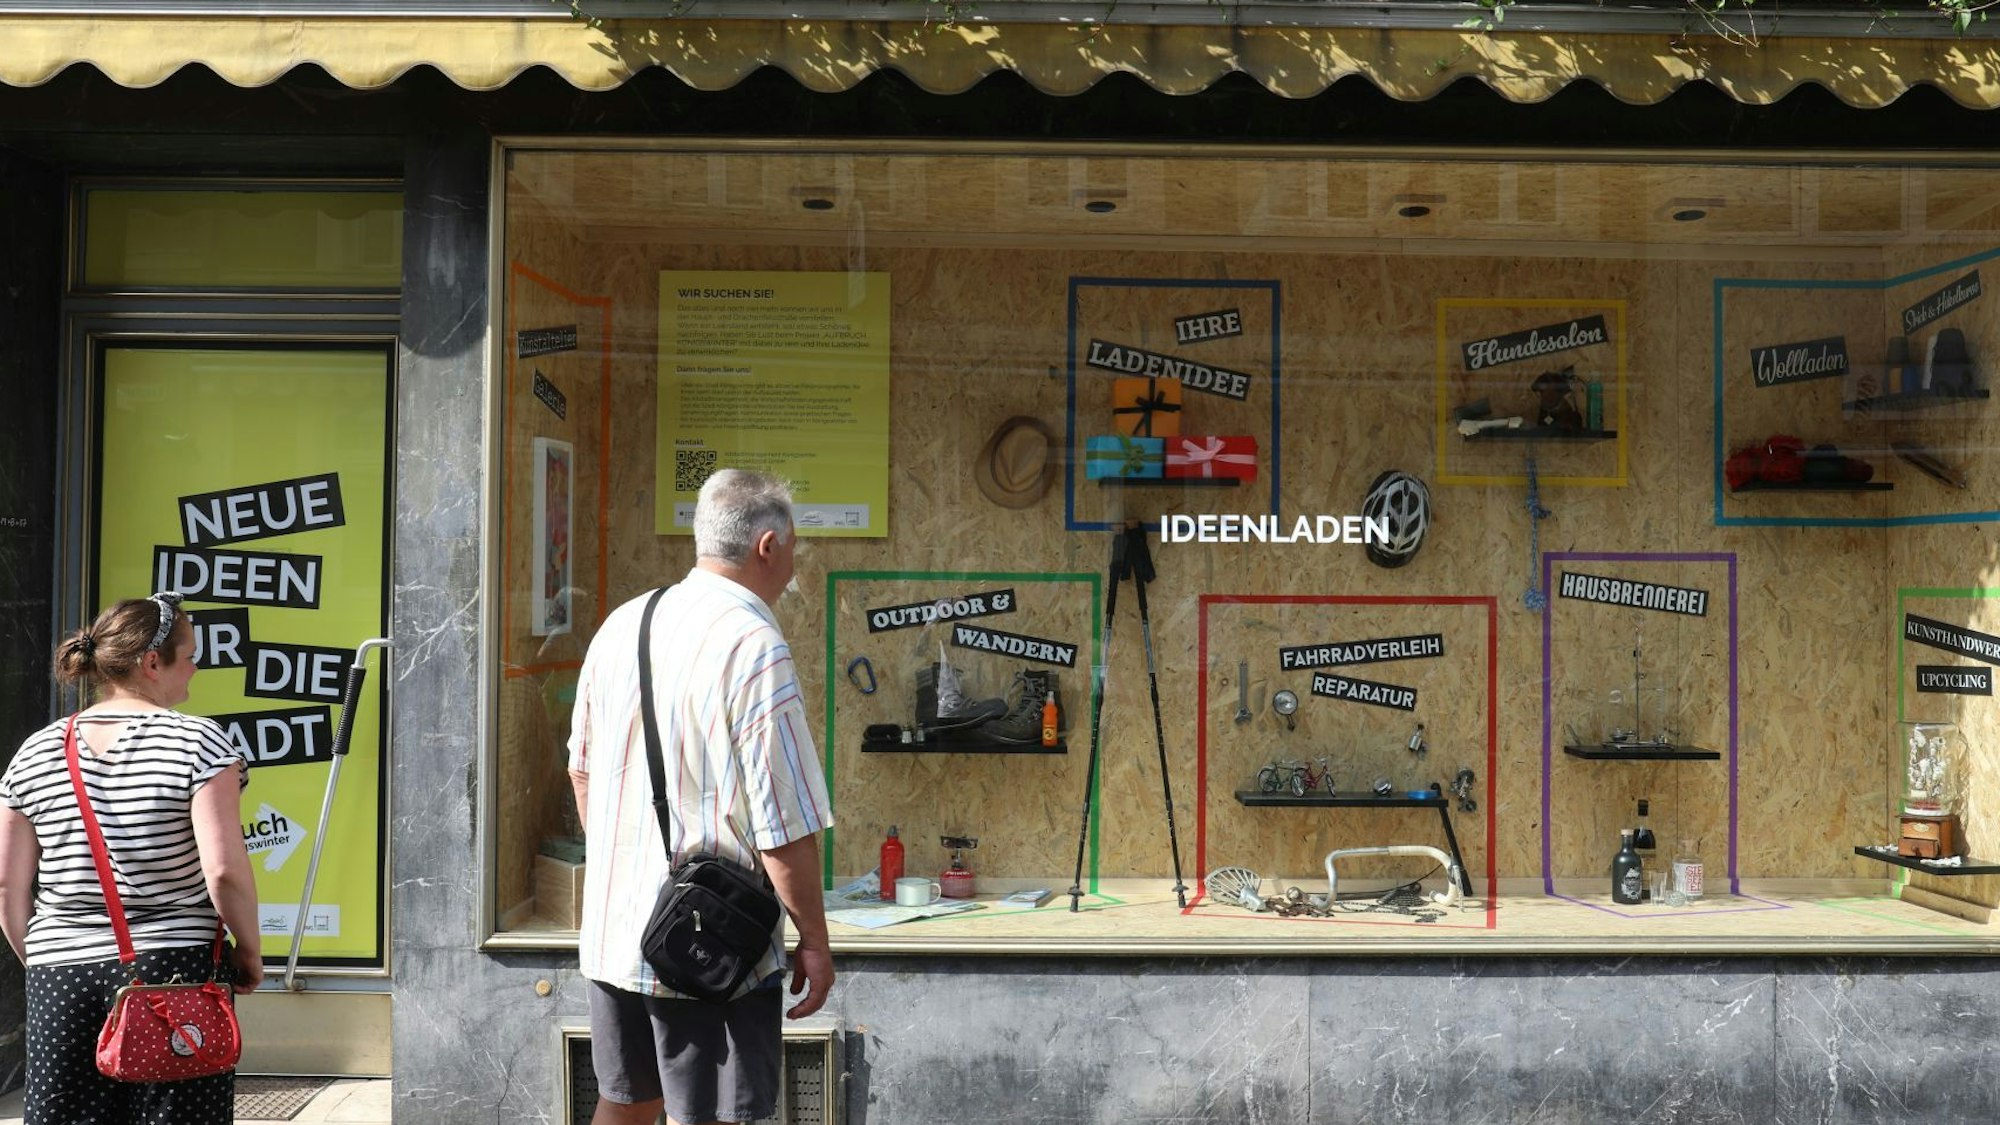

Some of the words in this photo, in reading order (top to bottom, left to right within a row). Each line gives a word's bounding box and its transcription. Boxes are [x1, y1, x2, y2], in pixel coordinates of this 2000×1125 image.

[678, 288, 701, 299] WIR
[703, 288, 751, 299] SUCHEN
[754, 288, 774, 299] SIE!
[1927, 305, 1935, 318] &
[1176, 312, 1240, 341] IHRE
[1468, 322, 1603, 369] Hundesalon
[1089, 343, 1247, 397] LADENIDEE
[1758, 346, 1845, 383] Wollladen
[185, 480, 334, 543] NEUE
[1160, 514, 1390, 544] IDEENLADEN
[158, 551, 317, 603] IDEEN
[1562, 573, 1706, 615] HAUSBRENNEREI
[873, 597, 987, 629] OUTDOOR
[991, 594, 1010, 611] &
[955, 627, 1074, 665] WANDERN
[1283, 637, 1440, 668] FAHRRADVERLEIH
[255, 648, 342, 697] DIE
[1921, 672, 1987, 689] UPCYCLING
[1313, 676, 1415, 708] REPARATUR
[225, 714, 325, 762] ADT
